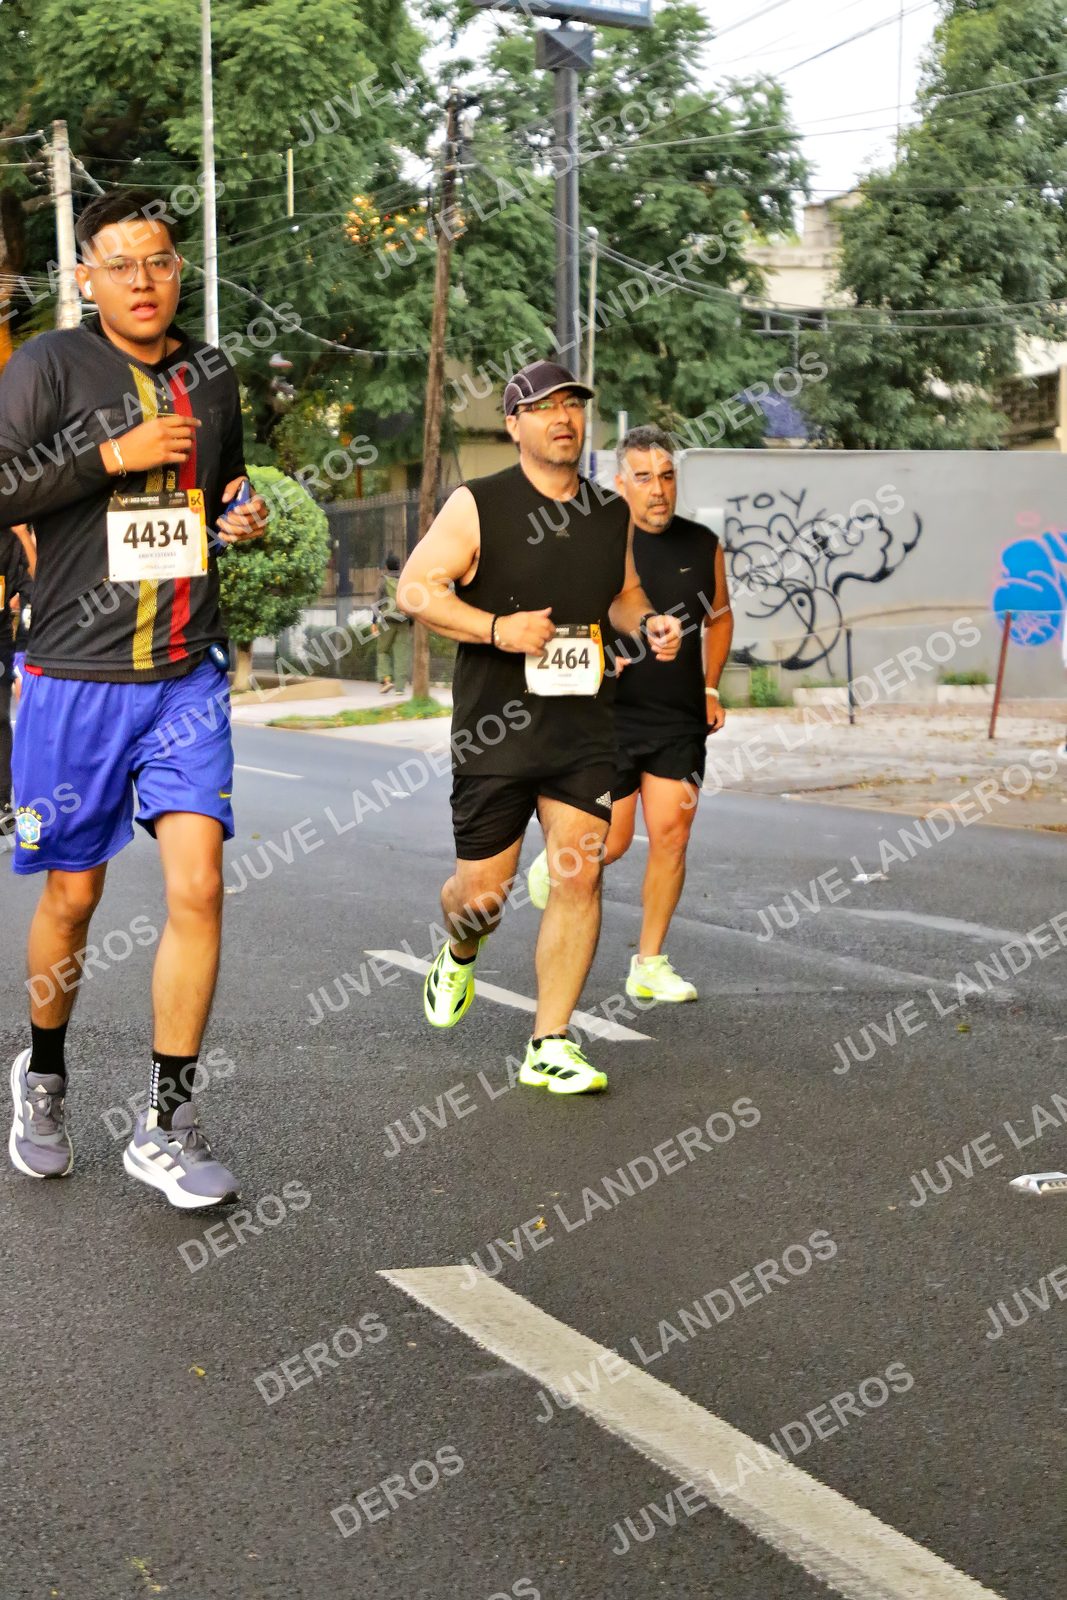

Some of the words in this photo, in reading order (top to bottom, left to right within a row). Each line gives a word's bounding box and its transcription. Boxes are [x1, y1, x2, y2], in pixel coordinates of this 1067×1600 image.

[726, 488, 806, 519] TOY
[123, 519, 188, 549] 4434
[537, 646, 590, 670] 2464
